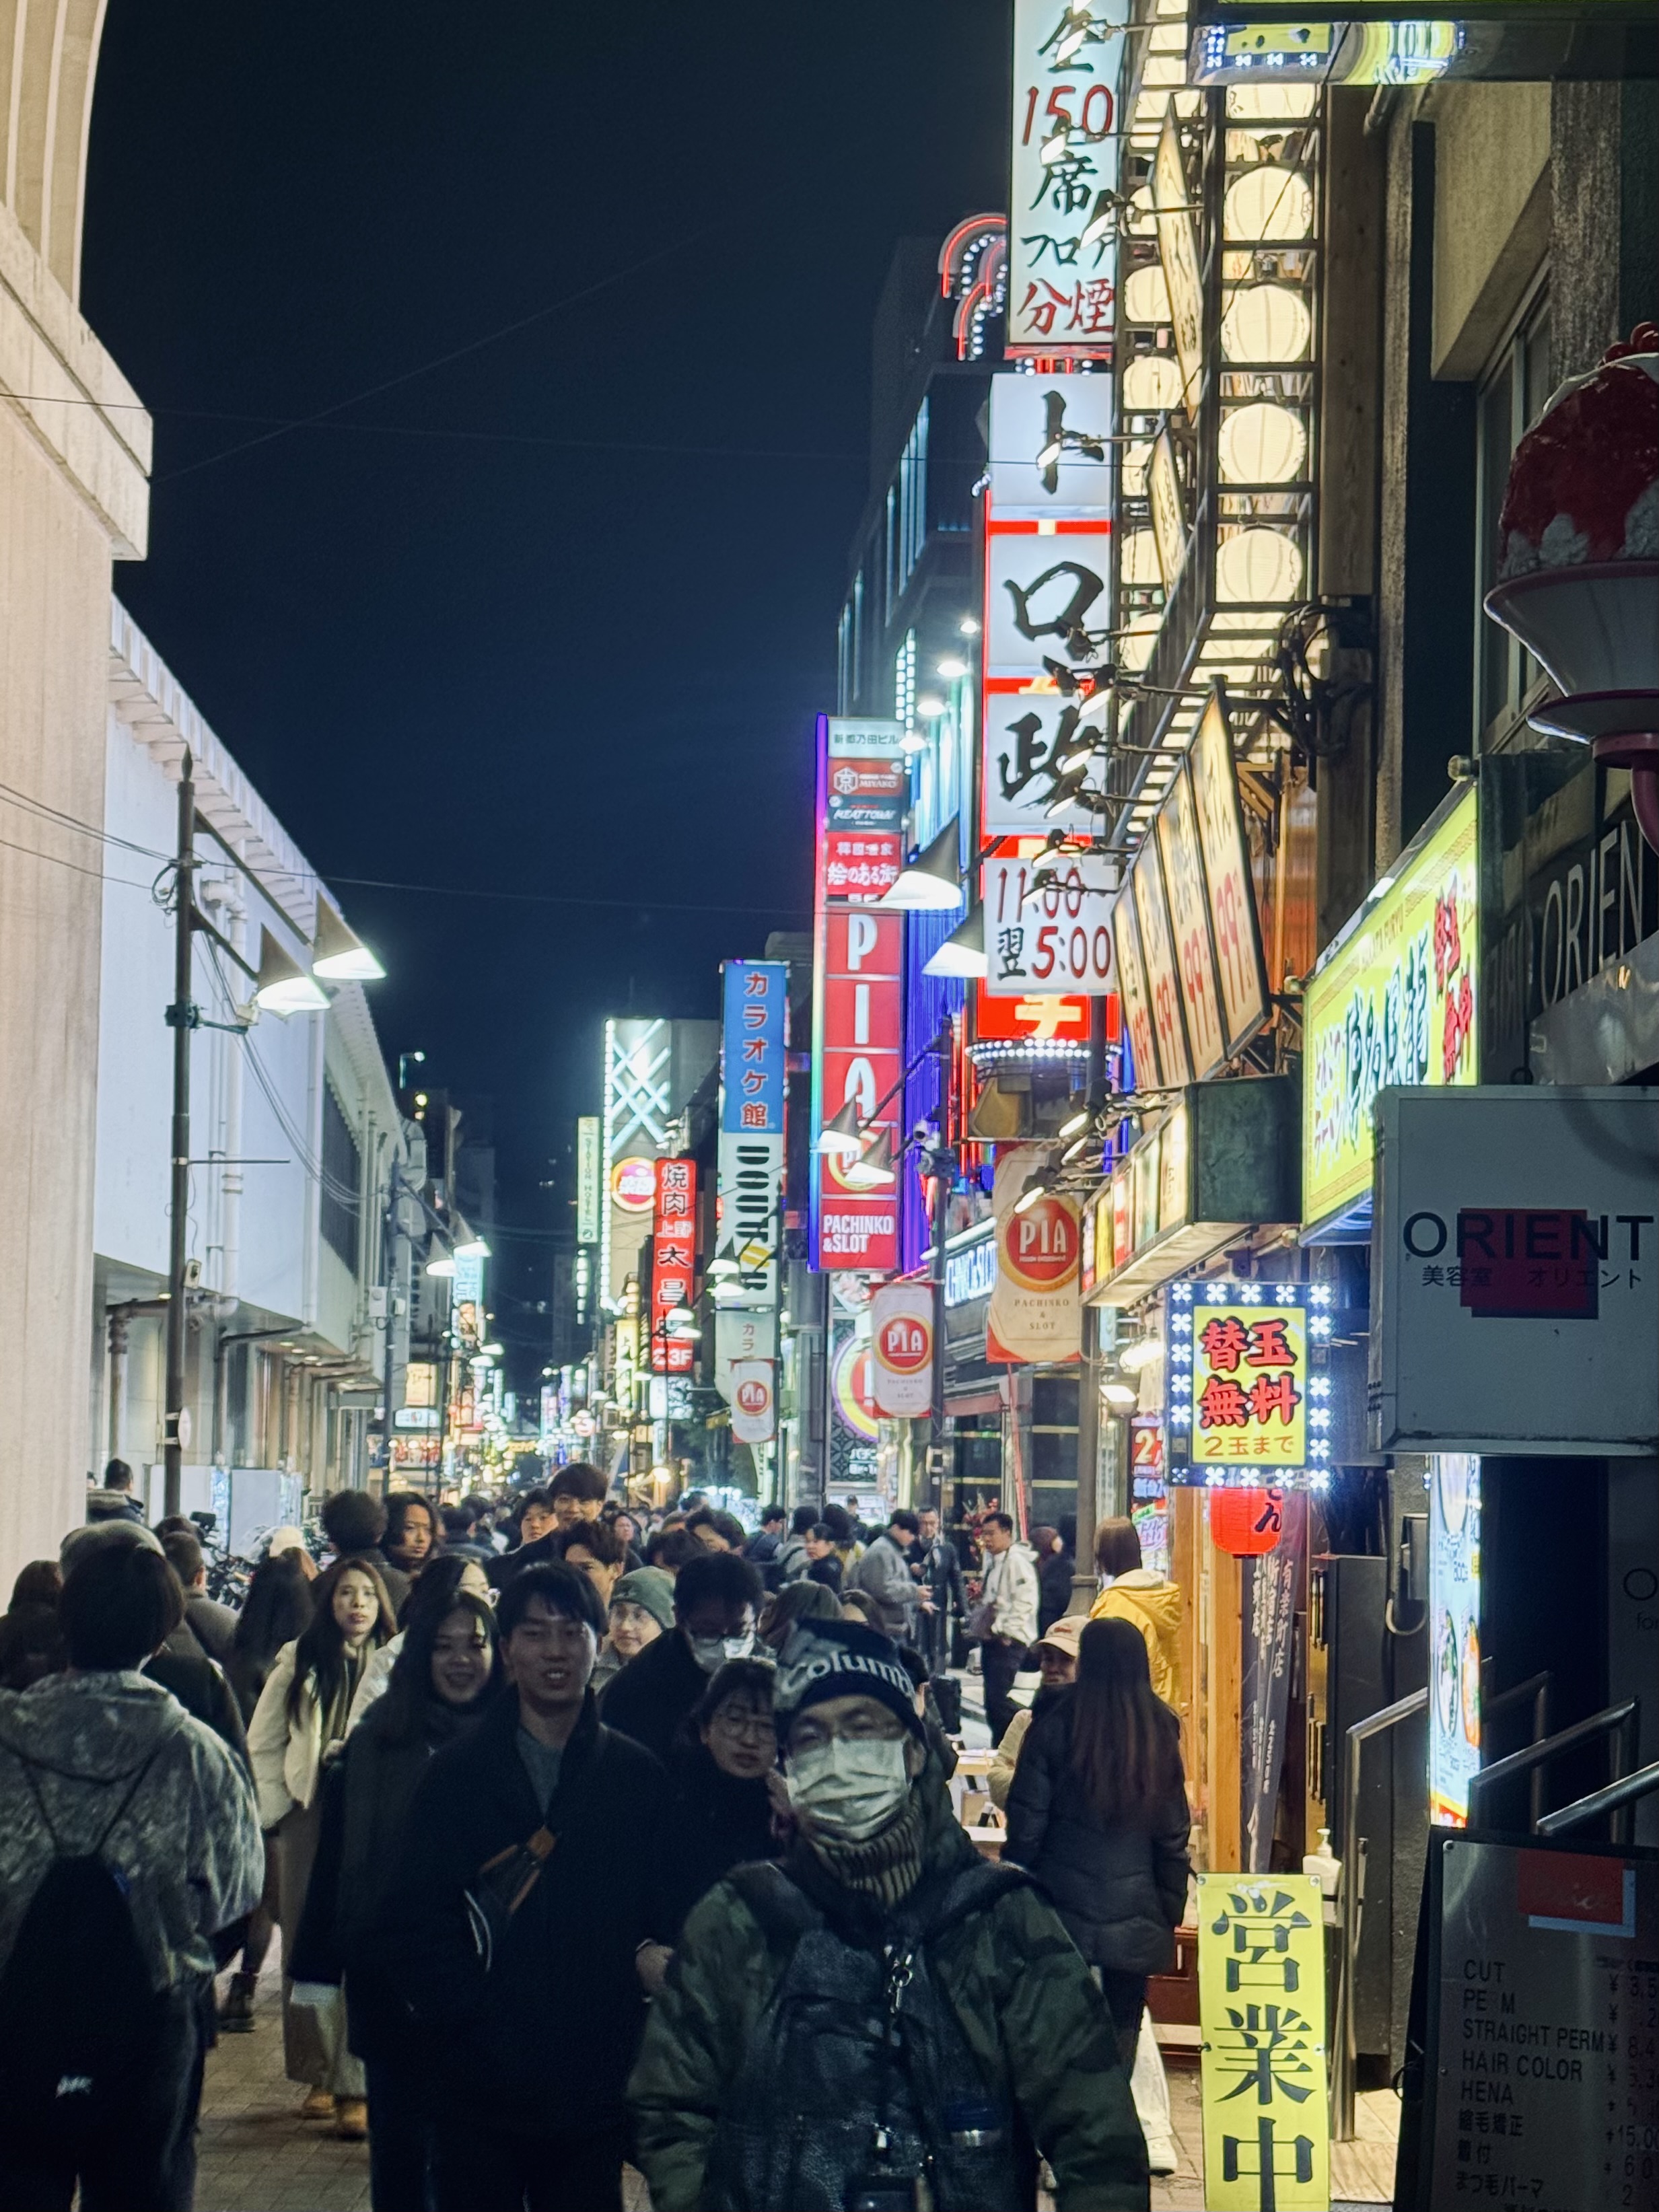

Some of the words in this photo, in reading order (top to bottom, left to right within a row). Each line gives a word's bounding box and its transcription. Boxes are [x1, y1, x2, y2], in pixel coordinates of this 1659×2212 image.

[1022, 85, 1114, 145] 150
[1028, 150, 1099, 215] 席
[1017, 277, 1114, 335] 分煙
[845, 913, 878, 1118] PIA
[740, 973, 770, 1129] カラオケ館
[663, 1164, 688, 1215] 焼肉
[656, 1220, 693, 1239] 上野
[823, 1214, 894, 1236] PACHINKO
[1020, 1219, 1068, 1254] PIA
[1403, 1211, 1654, 1261] ORIENT
[1422, 1265, 1493, 1287] 美容室
[1527, 1266, 1642, 1289] オリエント
[1014, 1299, 1070, 1307] PACHINKO
[742, 1323, 755, 1359] カラ
[887, 1329, 923, 1352] PIA
[1029, 1322, 1056, 1330] SLOT
[1201, 1316, 1298, 1372] 替玉
[742, 1386, 765, 1403] PIA
[1199, 1371, 1301, 1429] 無料
[1204, 1435, 1295, 1457] 2玉まで
[1463, 1959, 1506, 1985] CUT
[1463, 1989, 1515, 2015] PEM
[1212, 1891, 1317, 2212] 営業中
[1462, 2018, 1550, 2048] STRAIGHT
[1557, 2026, 1604, 2052] PERM
[1462, 2050, 1509, 2074] HAIR
[1517, 2056, 1583, 2082] COLOR
[1461, 2081, 1514, 2106] HENA
[1456, 2170, 1544, 2198] まつ毛パーマ
